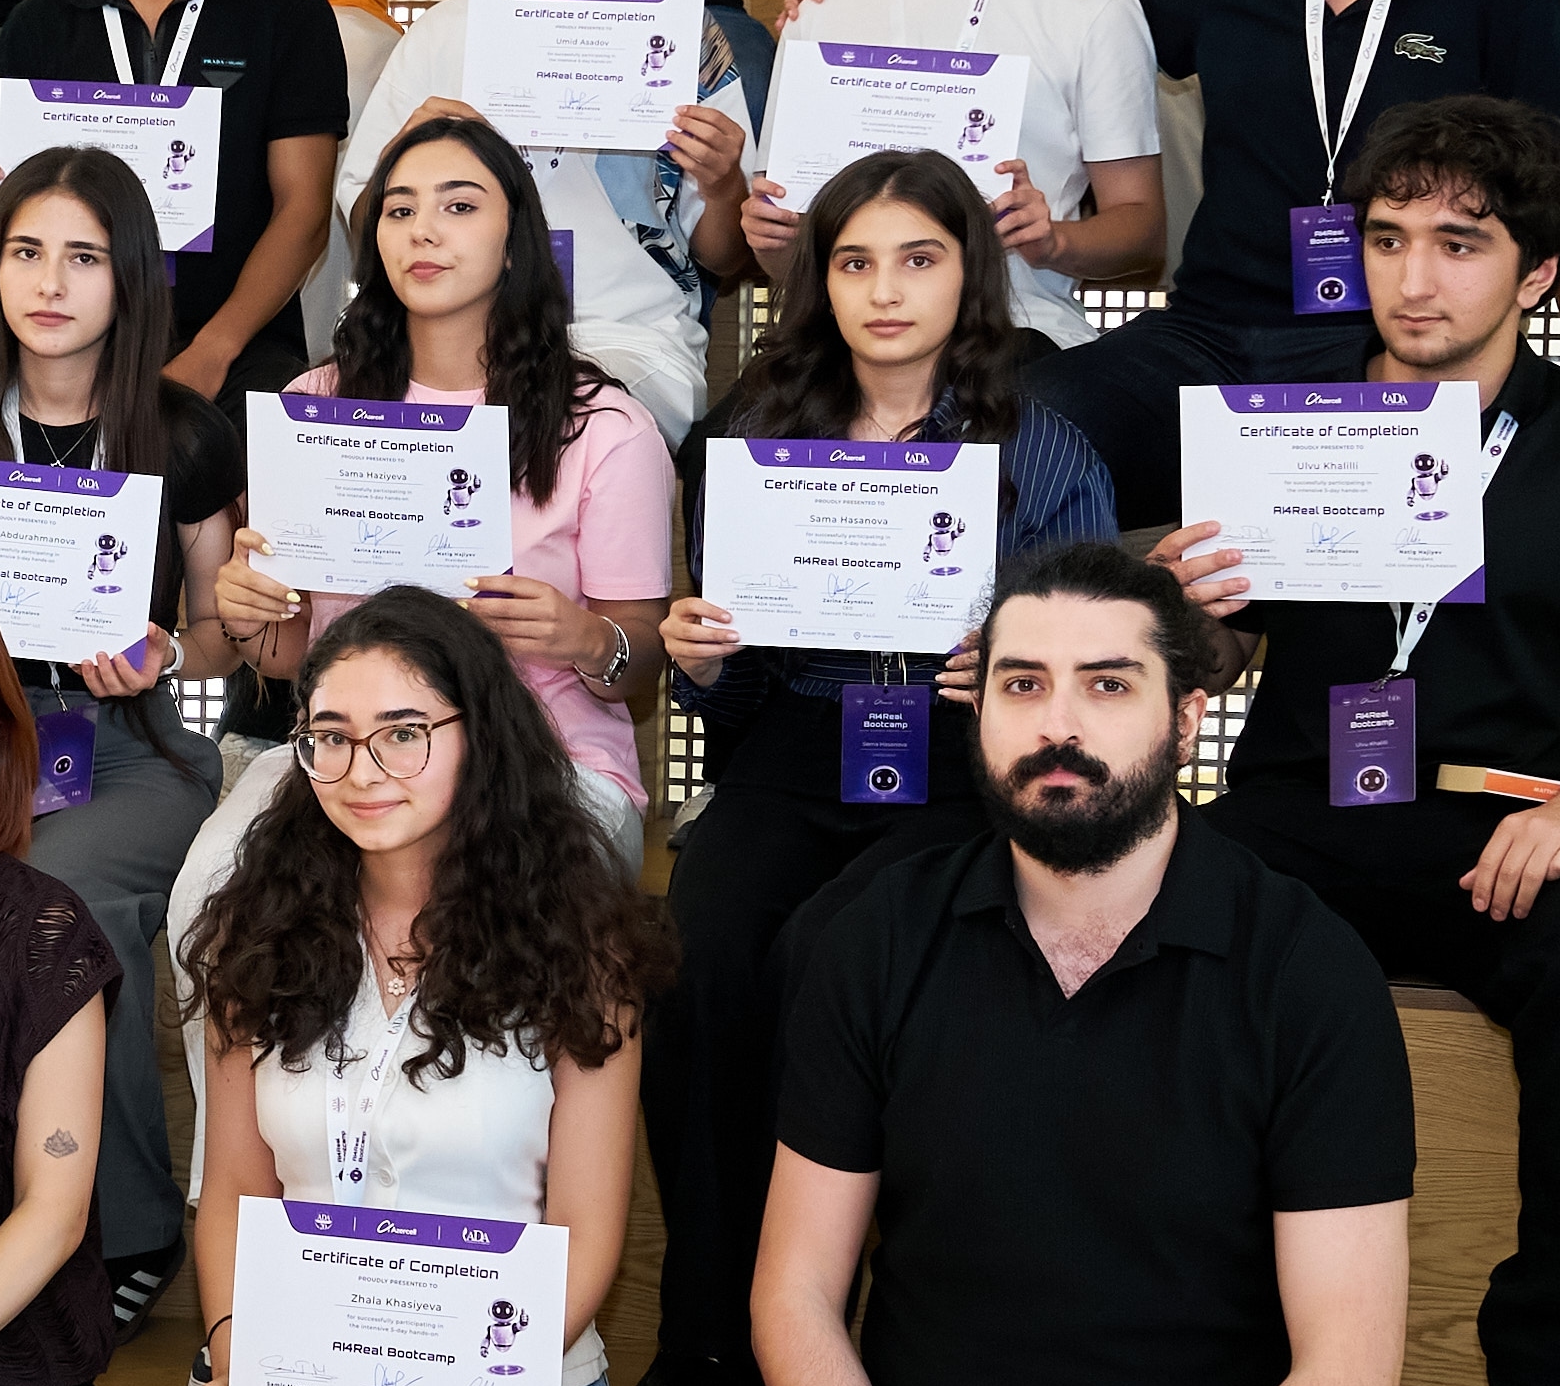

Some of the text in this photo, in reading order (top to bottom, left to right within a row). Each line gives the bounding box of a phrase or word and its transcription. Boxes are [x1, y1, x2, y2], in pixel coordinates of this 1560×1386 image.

[515, 9, 655, 22] Certificate of Completion
[537, 72, 623, 82] AI4Real Bootcamp
[830, 77, 976, 95] Certificate of Completion
[43, 112, 99, 122] Certificate
[116, 116, 175, 127] Completion
[862, 107, 935, 119] Ahmad Afandiyev
[1240, 425, 1418, 438] Certificate of Completion
[297, 433, 454, 453] Certificate of Completion
[1297, 461, 1358, 471] Ulvu Khalilli
[339, 470, 407, 481] Sama Haziyeva
[764, 479, 939, 495] Certificate of Completion
[18, 500, 30, 511] of
[34, 502, 105, 519] Completion
[325, 508, 424, 523] AI4Real Bootcamp
[1273, 505, 1384, 517] AI4Real Bootcamp
[810, 515, 888, 525] Sama Hasanova
[0, 530, 76, 545] Abdurahmanova
[794, 556, 901, 571] AI4Real Bootcamp
[13, 571, 68, 585] Bootcamp
[864, 720, 908, 730] Bootcamp
[469, 1229, 490, 1244] ADA
[302, 1249, 499, 1280] Certificate of Completion
[358, 1276, 388, 1284] PROUDLY
[390, 1279, 428, 1288] PRESENTED
[351, 1294, 442, 1313] Zhala Khasiyeva
[333, 1342, 455, 1364] AI4Real Bootcamp
